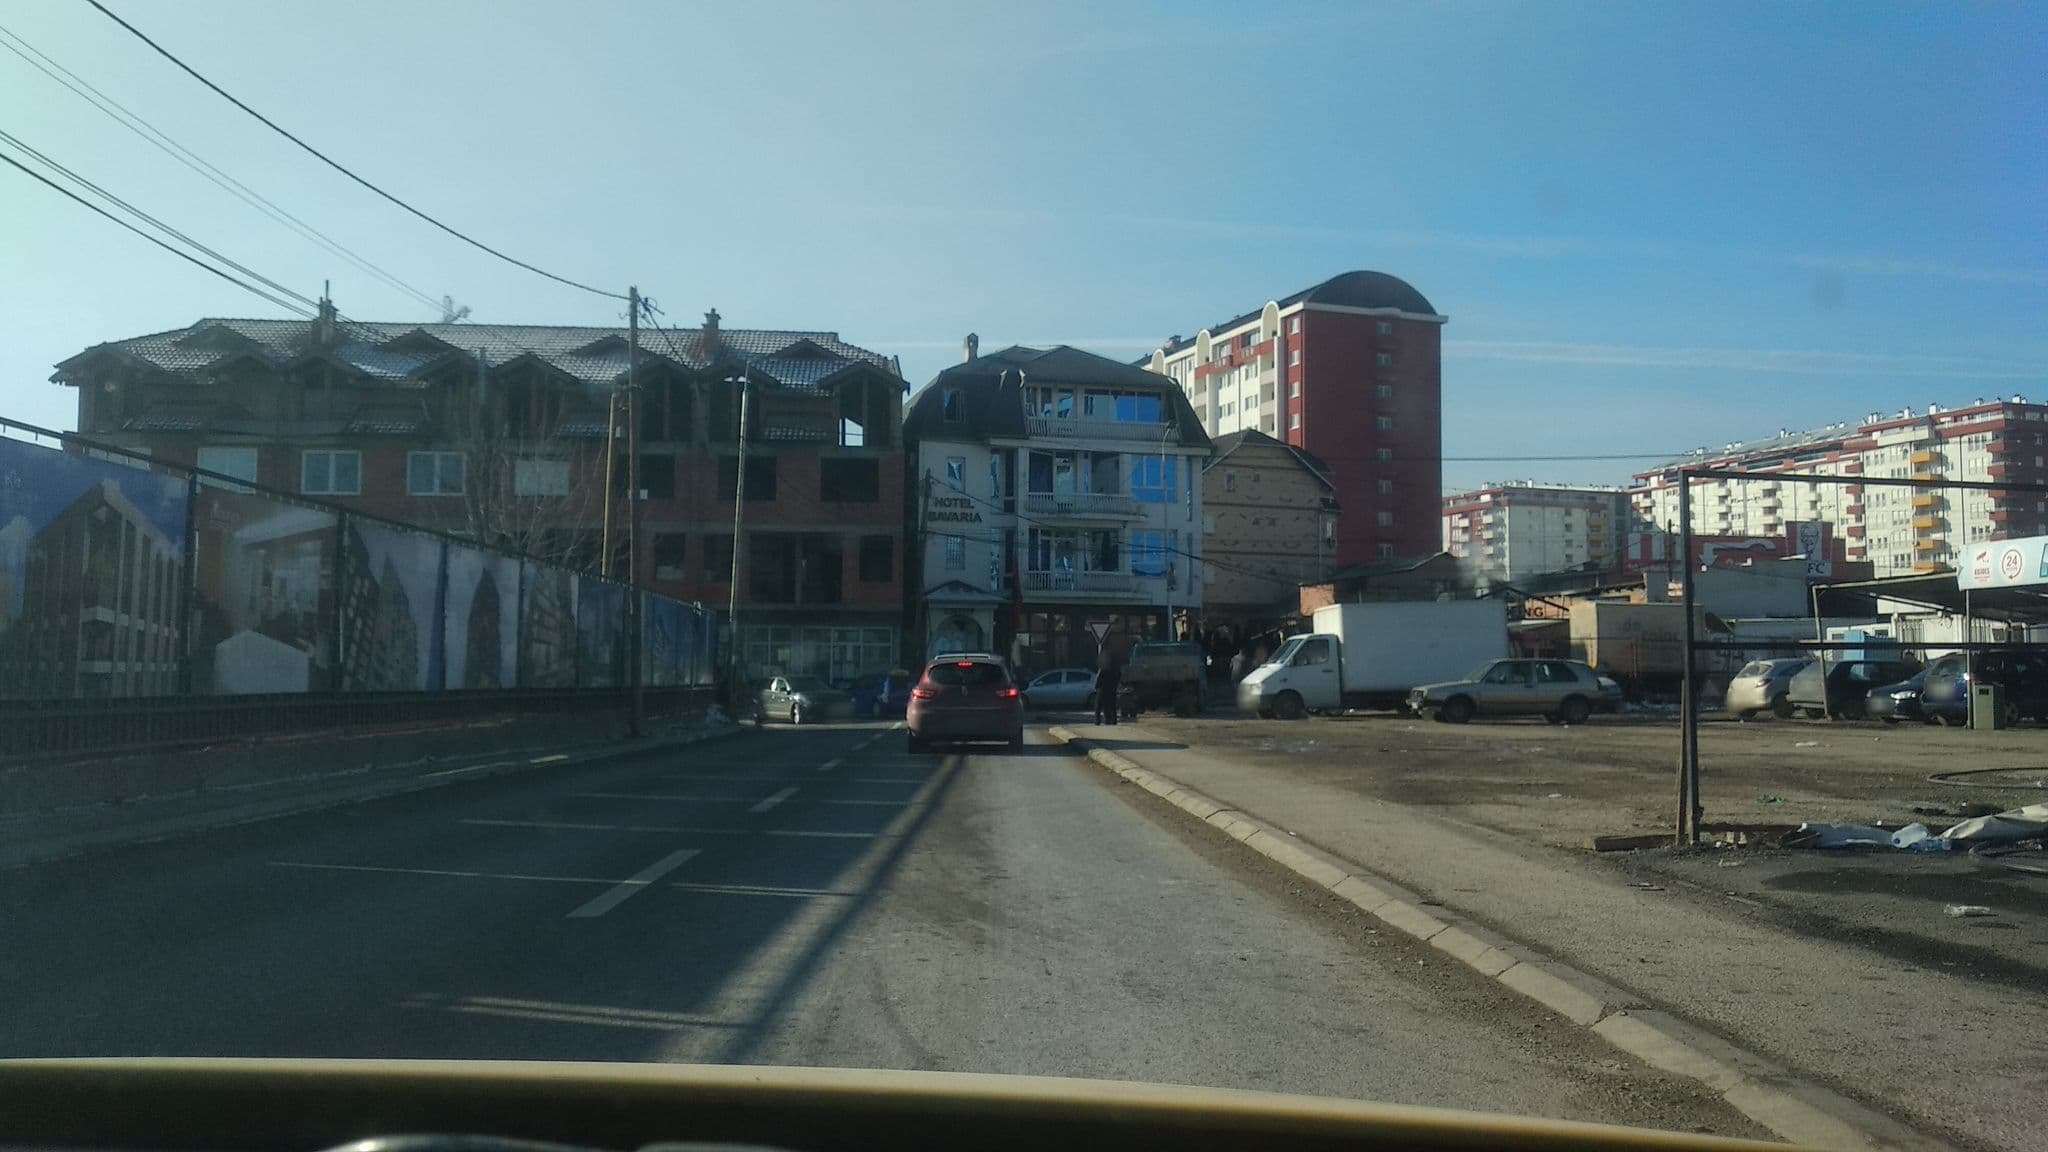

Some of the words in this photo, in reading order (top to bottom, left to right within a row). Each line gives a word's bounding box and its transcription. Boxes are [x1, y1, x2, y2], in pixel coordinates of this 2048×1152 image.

[934, 497, 975, 509] HOTEL
[928, 511, 983, 523] BAVARIA
[2006, 555, 2018, 568] 24
[1807, 562, 1826, 574] FC
